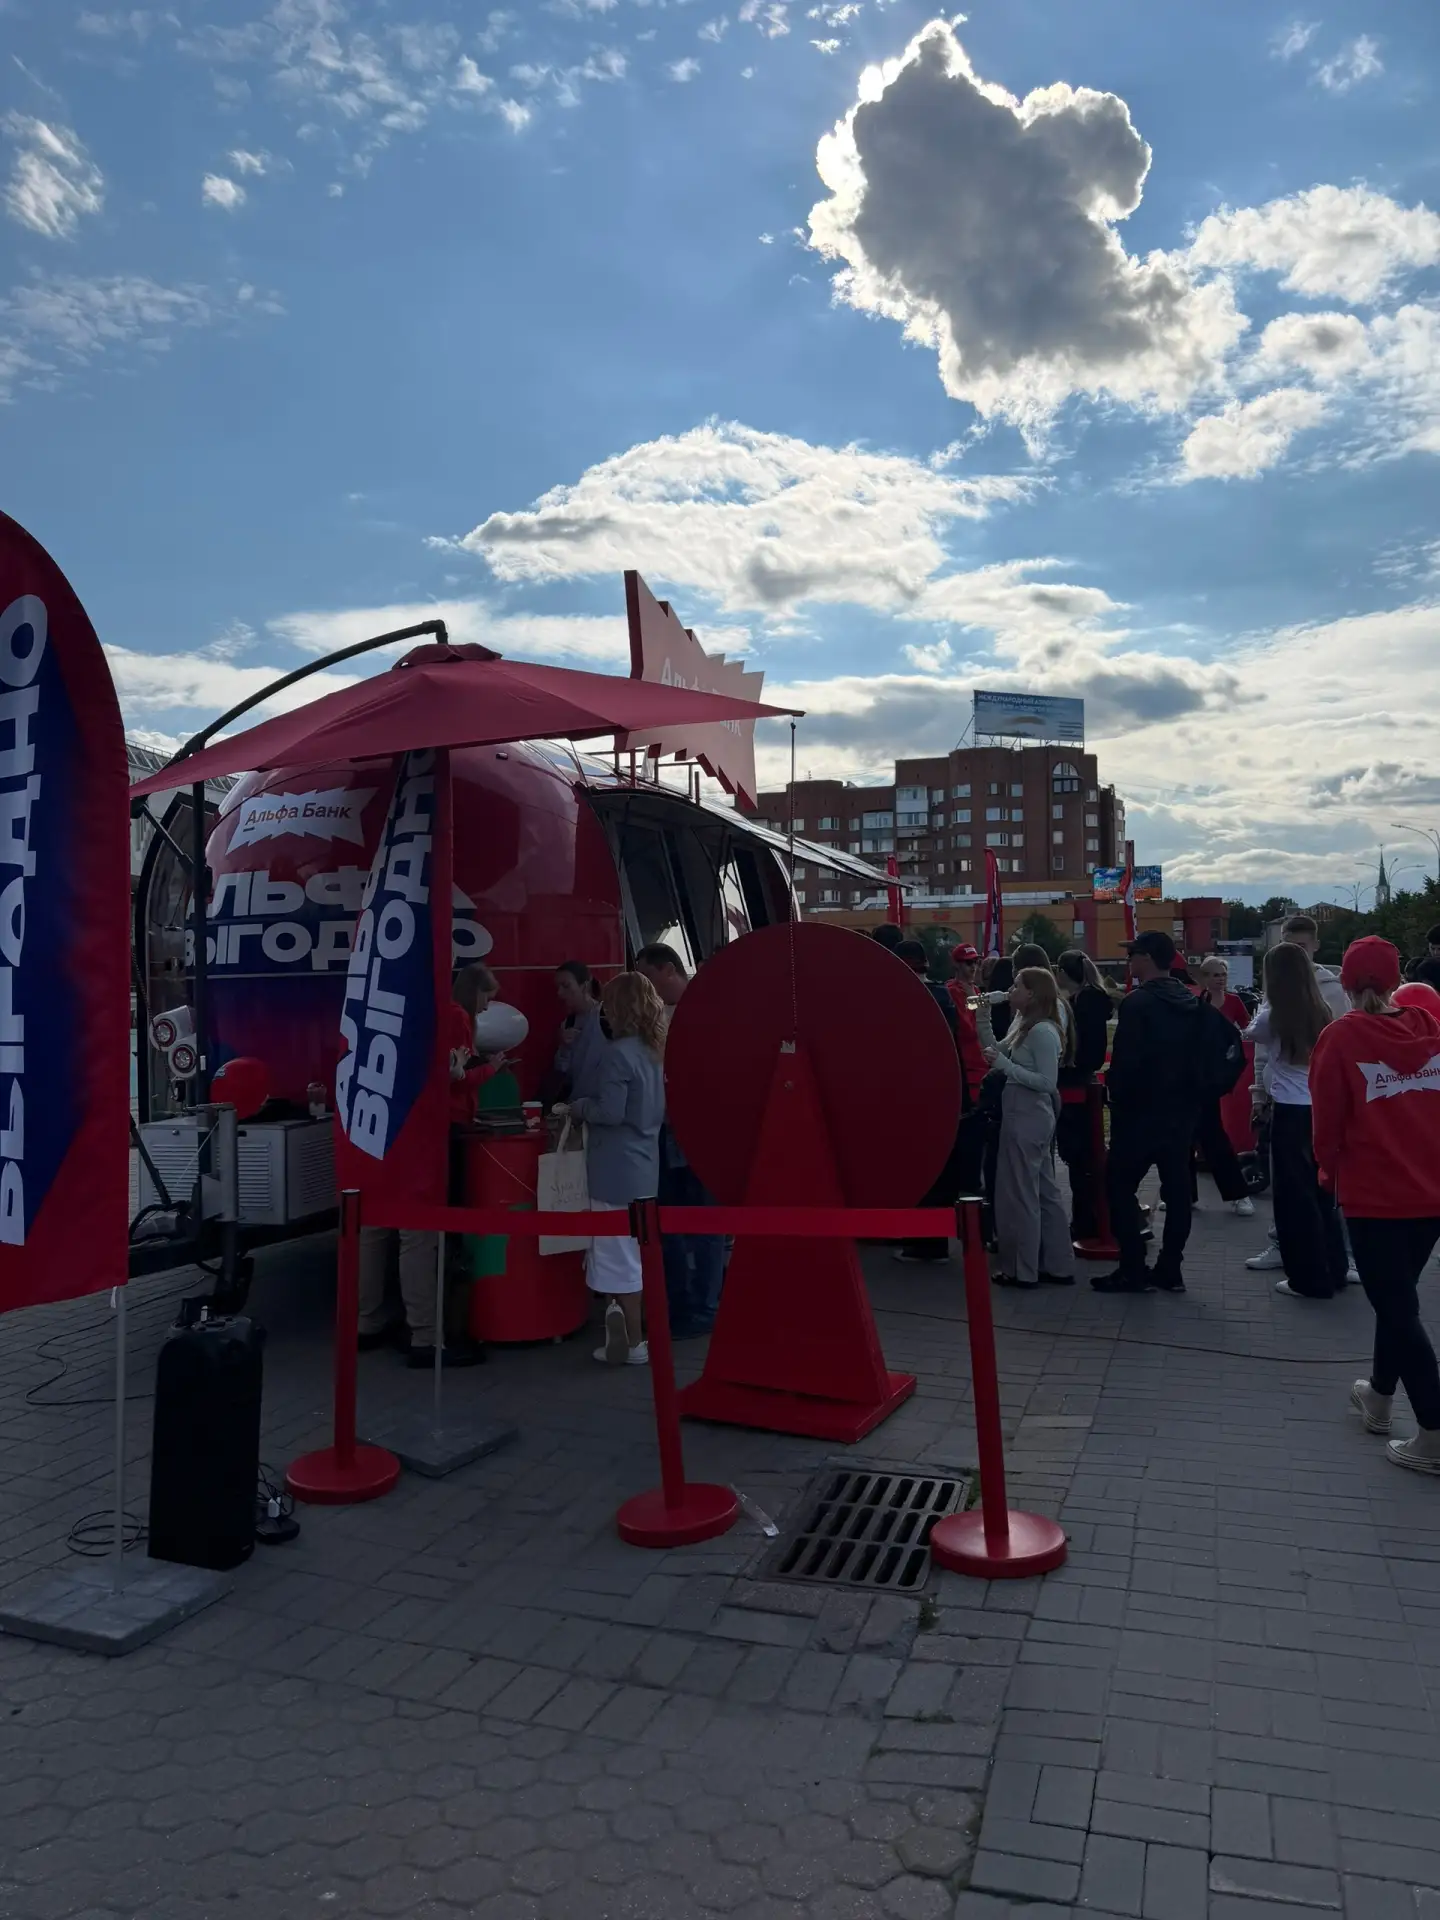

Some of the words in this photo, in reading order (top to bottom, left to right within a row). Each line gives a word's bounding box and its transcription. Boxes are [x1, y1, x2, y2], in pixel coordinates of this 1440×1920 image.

[243, 804, 299, 831] Альфа
[302, 802, 351, 819] Банк
[186, 865, 478, 921] ЛЬФ
[184, 917, 494, 971] ВЫГОДО
[1415, 1067, 1440, 1079] Бан
